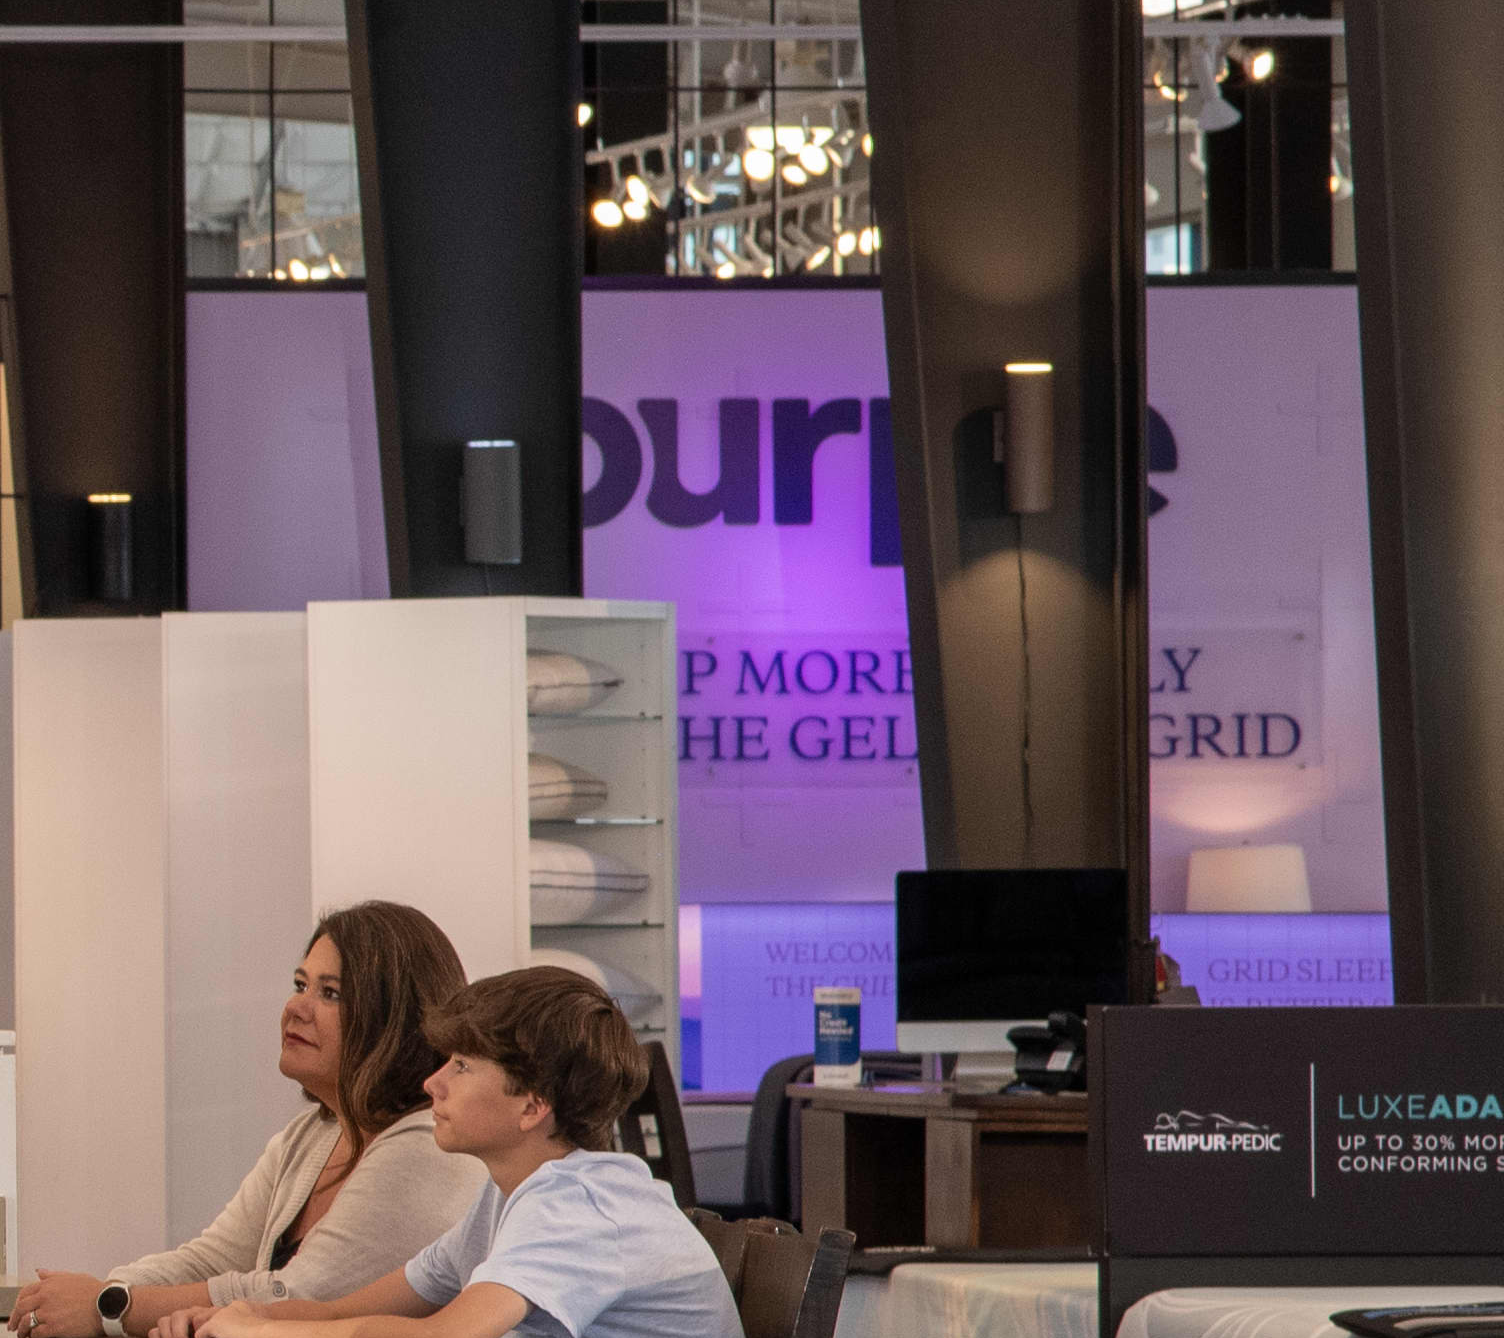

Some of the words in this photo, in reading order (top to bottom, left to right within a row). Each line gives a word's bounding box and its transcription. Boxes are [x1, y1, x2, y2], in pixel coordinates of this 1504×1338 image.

[788, 715, 919, 761] GEL
[1149, 712, 1302, 760] GRID
[1207, 958, 1290, 983] GRID
[1143, 1132, 1281, 1152] TEMPUR-PEDIC
[1338, 1134, 1366, 1151] UP
[1375, 1134, 1403, 1151] TO
[1412, 1134, 1455, 1151] 30%
[1464, 1134, 1504, 1151] MO
[1338, 1155, 1487, 1173] CONFORMING
